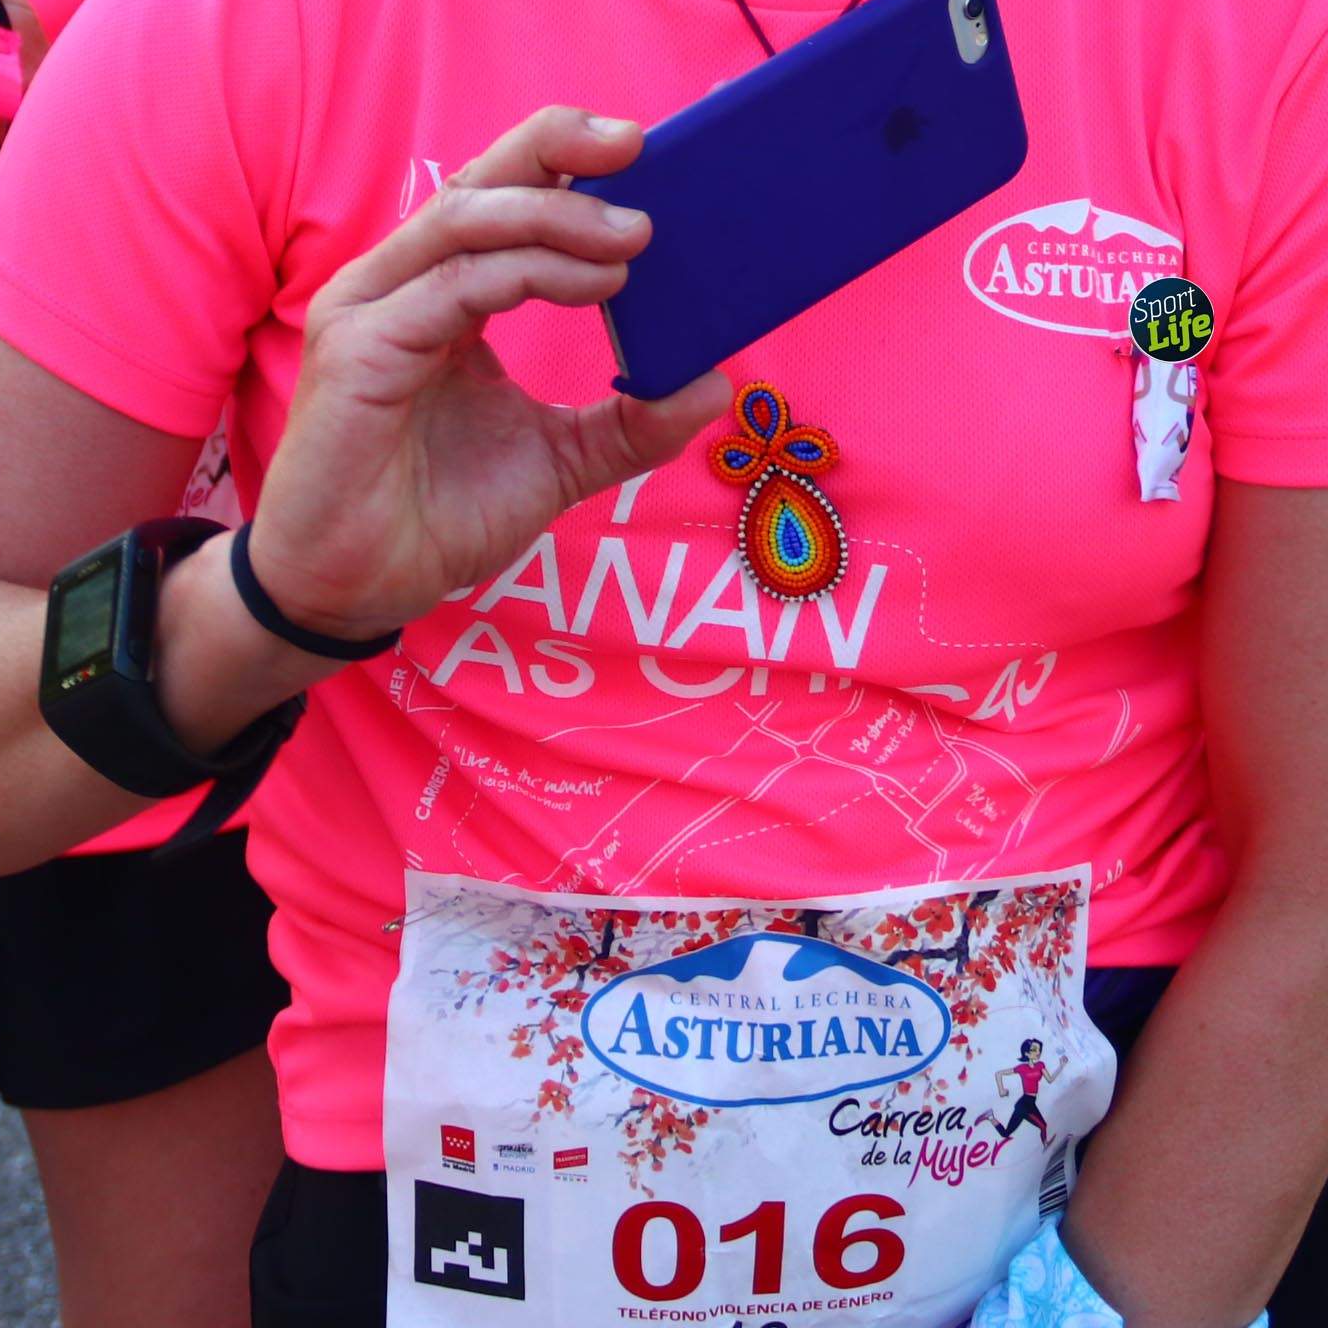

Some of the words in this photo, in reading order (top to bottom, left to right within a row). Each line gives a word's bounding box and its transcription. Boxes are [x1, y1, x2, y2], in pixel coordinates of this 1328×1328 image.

[1096, 250, 1178, 265] LECHERA
[1134, 287, 1197, 323] Sport
[1147, 309, 1212, 353] Life
[440, 533, 888, 669] ANAN
[670, 991, 781, 1012] CENTRAL
[794, 990, 912, 1010] LECHERA
[608, 991, 923, 1063] ASTURIANA
[828, 1098, 967, 1137] Carrera
[503, 1164, 536, 1174] MADRID
[861, 1141, 886, 1166] de
[893, 1139, 912, 1165] la
[907, 1127, 1014, 1189] Mujer
[612, 1193, 907, 1302] 016
[618, 1306, 708, 1322] TELÉFONO
[710, 1301, 798, 1318] VIOLENCIA
[803, 1300, 826, 1312] DE
[828, 1290, 895, 1310] GÉNERO
